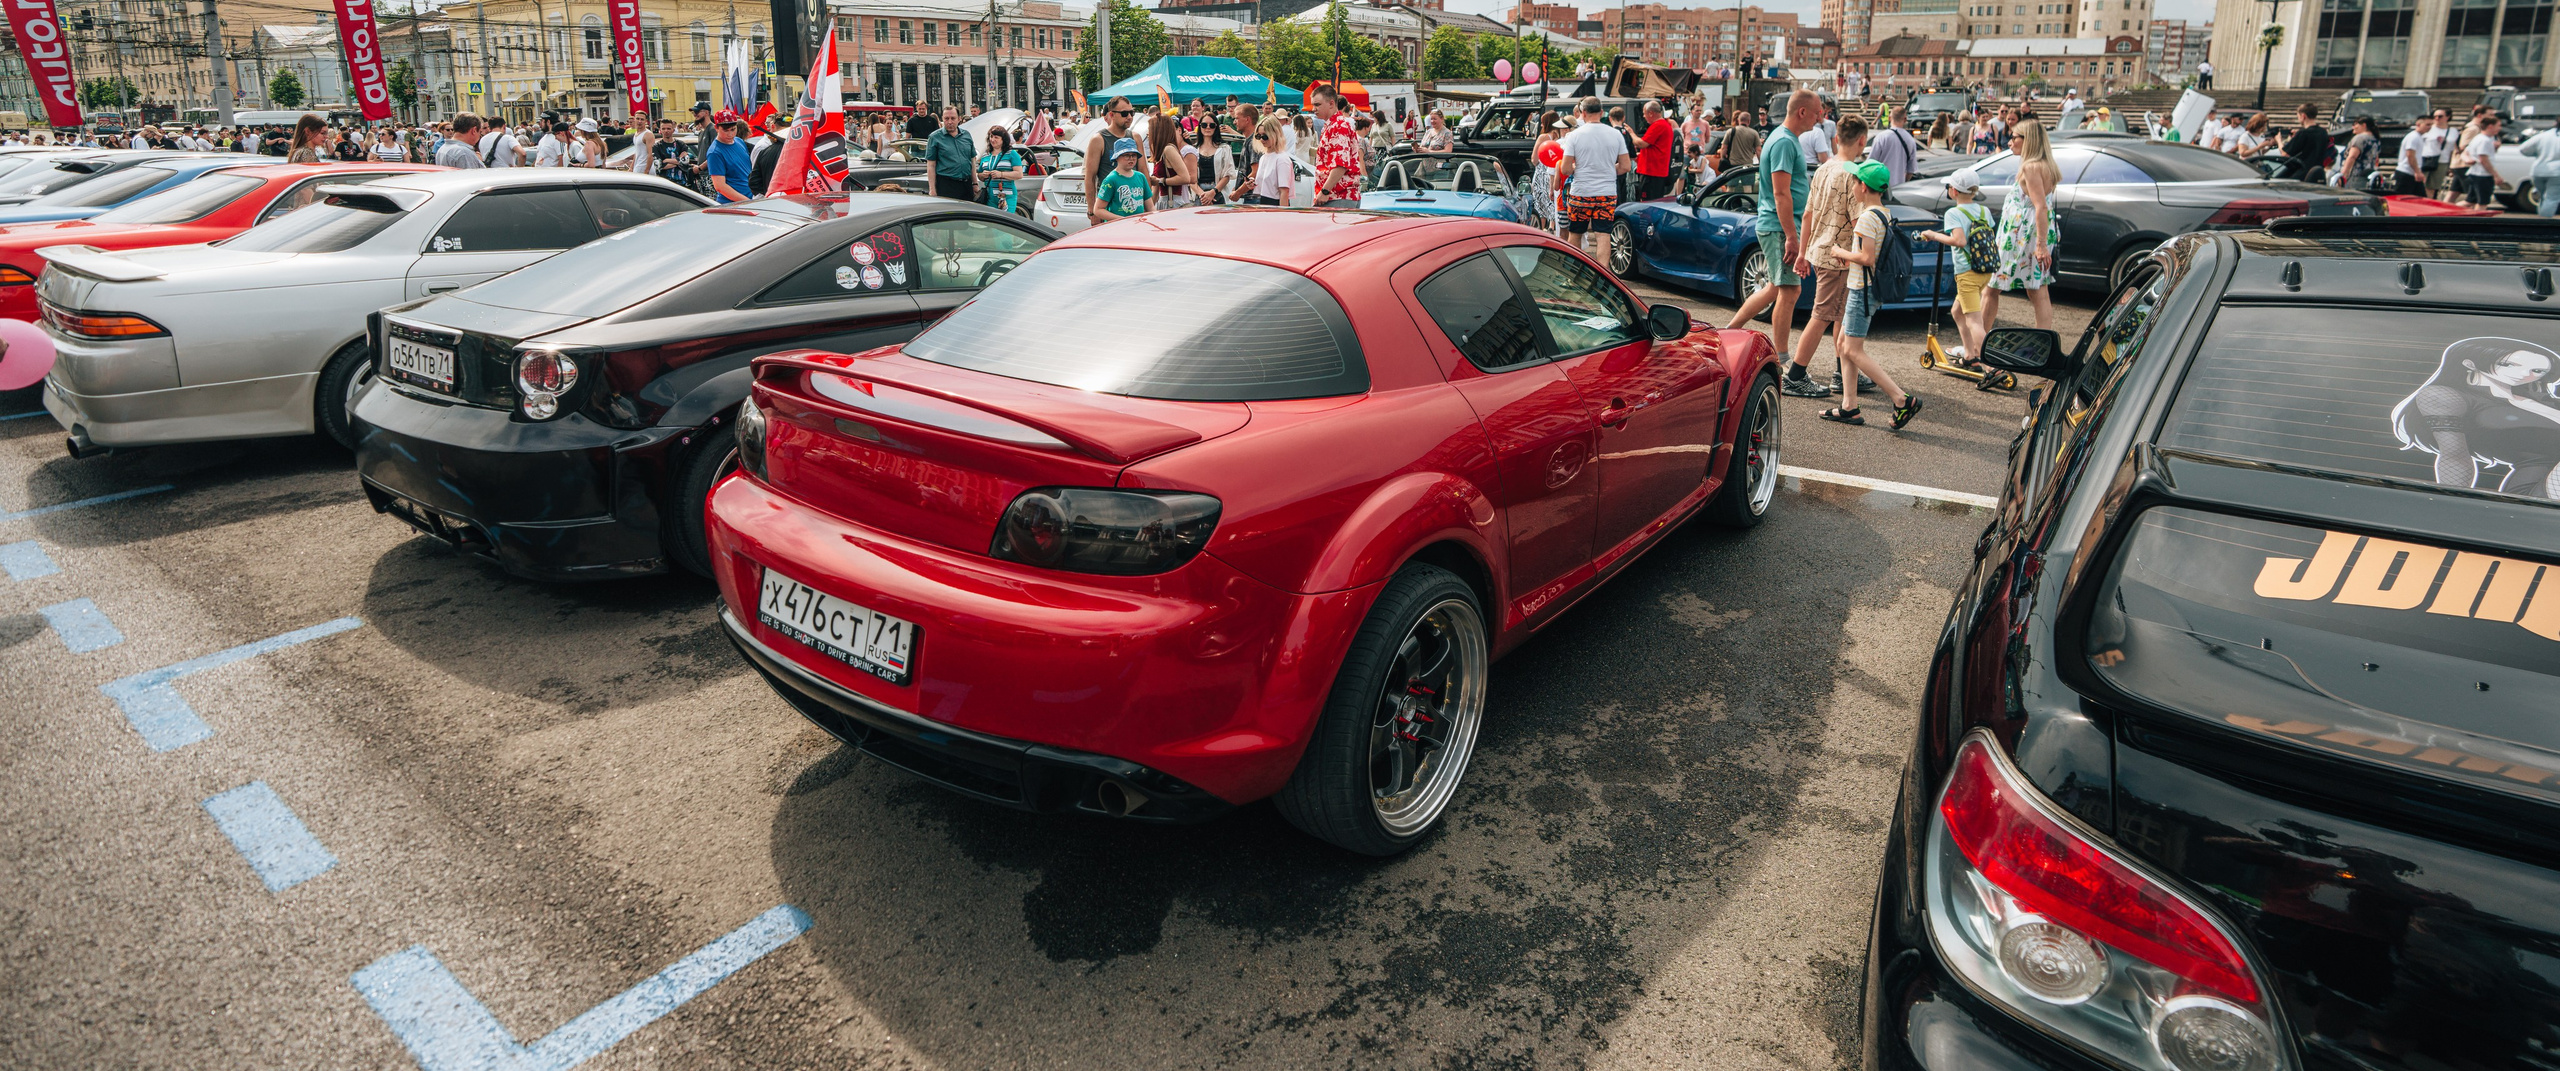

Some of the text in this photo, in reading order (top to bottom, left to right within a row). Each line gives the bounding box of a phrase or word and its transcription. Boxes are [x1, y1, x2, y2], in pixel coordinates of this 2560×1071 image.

[618, 2, 644, 103] auto.ru
[438, 352, 449, 373] 71
[760, 613, 897, 682] LIFE IS TOO SHORT TO DRIVE BORING CARS
[874, 613, 901, 653] 71
[867, 644, 889, 663] RUS
